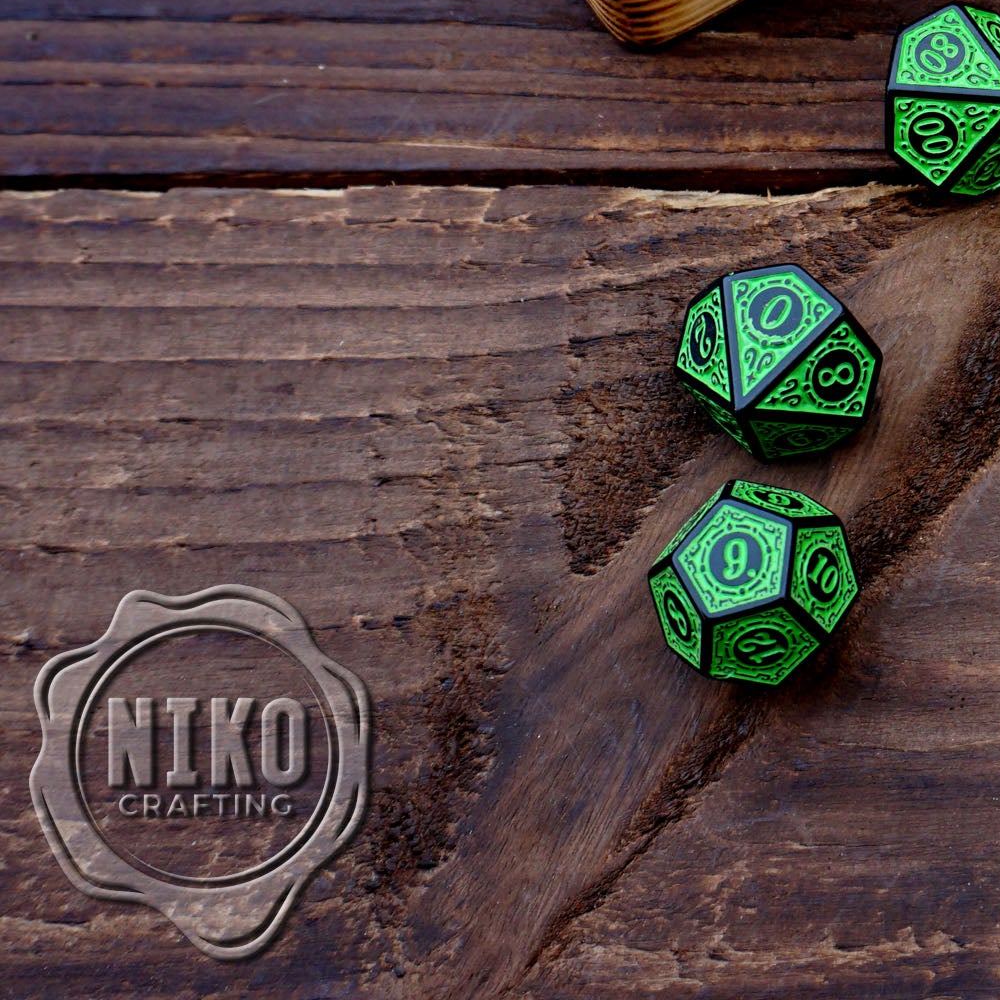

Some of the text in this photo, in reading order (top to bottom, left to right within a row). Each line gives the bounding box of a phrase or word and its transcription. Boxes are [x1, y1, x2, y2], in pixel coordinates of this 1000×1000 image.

[919, 34, 958, 73] 80
[913, 118, 953, 153] 00
[760, 295, 792, 330] 0
[818, 362, 854, 388] 8
[808, 554, 838, 593] 10
[668, 600, 688, 637] 8
[738, 632, 790, 663] 12
